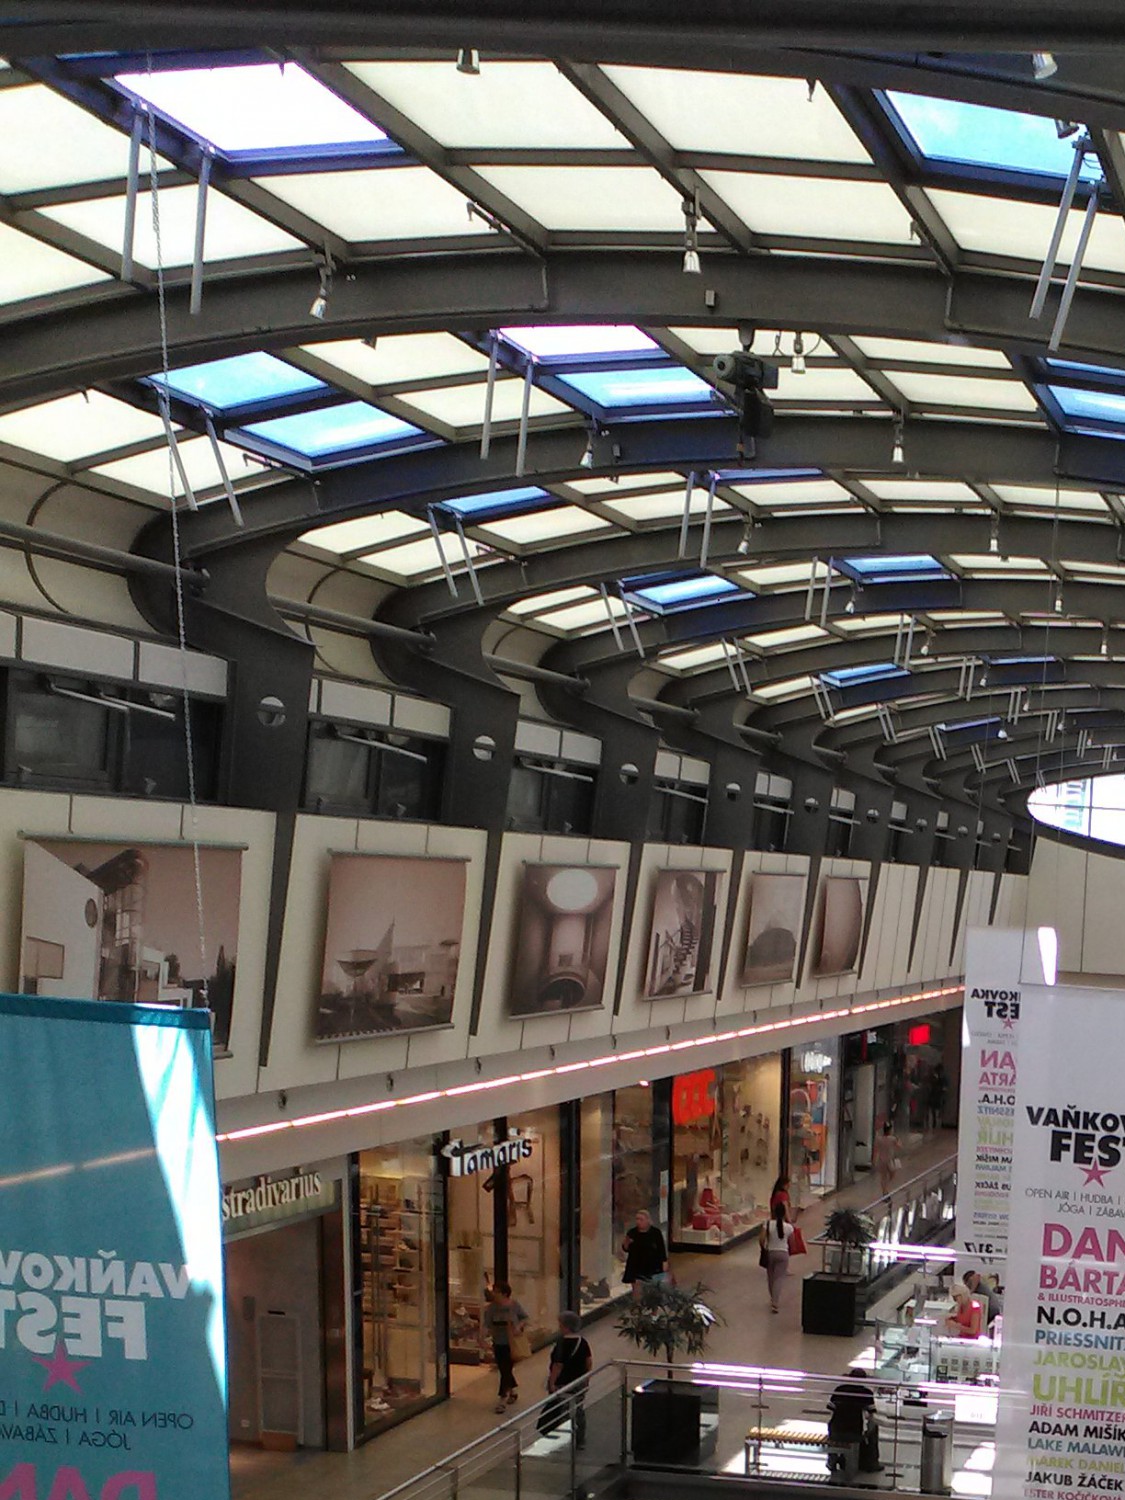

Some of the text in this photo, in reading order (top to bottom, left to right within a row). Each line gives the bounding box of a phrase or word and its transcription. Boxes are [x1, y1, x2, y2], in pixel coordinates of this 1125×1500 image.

[222, 1168, 322, 1221] stradivarius
[1025, 1188, 1053, 1199] OPEN
[1055, 1191, 1070, 1201] AIR
[1080, 1193, 1113, 1205] HUDBA
[1057, 1202, 1085, 1214] JÓGA
[1029, 1421, 1079, 1437] ADAM
[1028, 1437, 1062, 1452] LAKE
[1025, 1471, 1124, 1491] JAKUB ŽÁČEK
